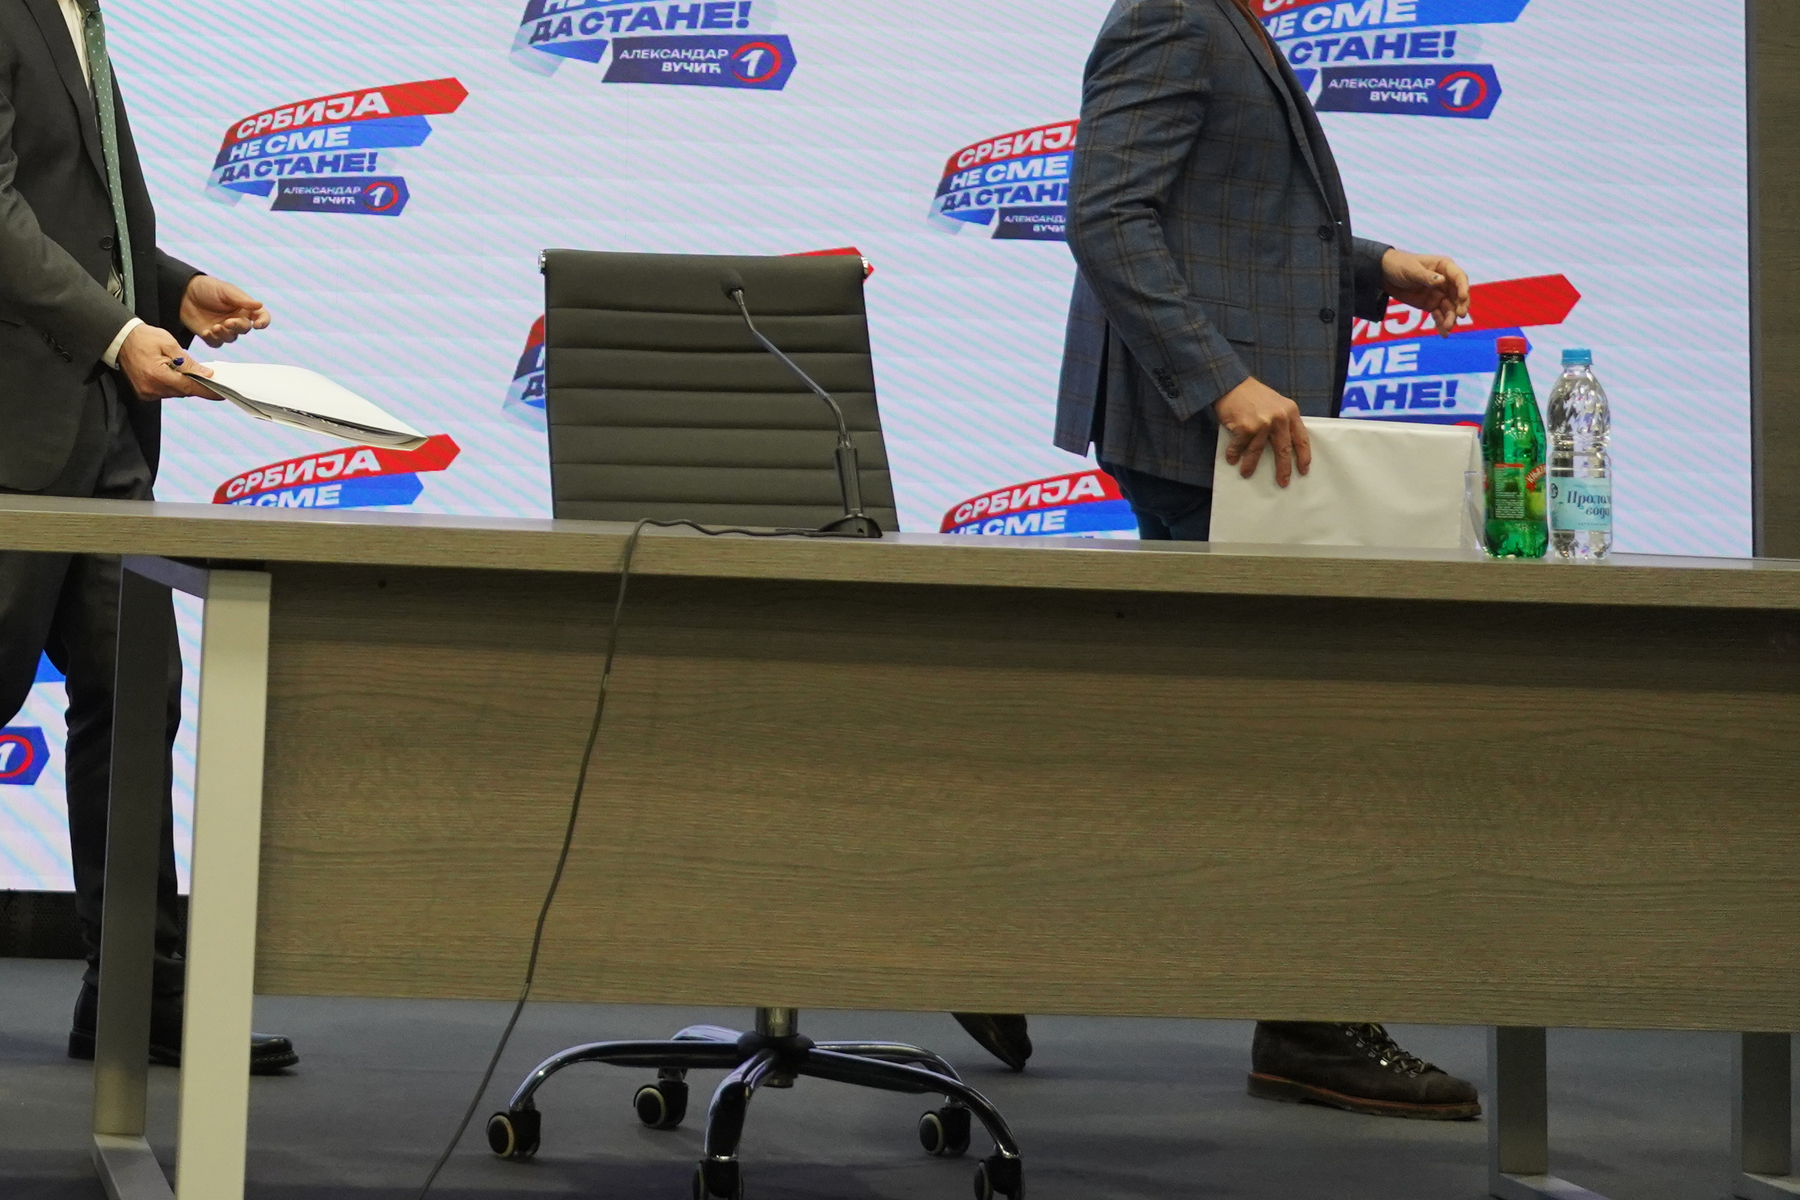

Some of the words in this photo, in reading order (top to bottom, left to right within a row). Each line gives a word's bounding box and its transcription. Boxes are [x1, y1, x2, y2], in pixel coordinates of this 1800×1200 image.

[528, 16, 574, 45] ДА
[579, 1, 752, 34] СТАНЕ!
[619, 49, 729, 61] АЛЕКСАНДАР
[1289, 31, 1456, 65] СТАНЕ!
[662, 62, 721, 73] ВУЧИЋ
[740, 50, 765, 76] 1
[1328, 78, 1436, 89] АЛЕКСАНДАР
[1370, 91, 1428, 103] ВУЧИЋ
[1447, 79, 1470, 105] 1
[236, 92, 390, 139] СРБИЈА
[229, 140, 262, 161] НЕ
[264, 126, 351, 153] СМЕ
[957, 125, 1076, 168] СРБИЈ
[218, 164, 250, 184] ДА
[253, 152, 378, 176] СТАНЕ!
[950, 168, 983, 191] НЕ
[985, 155, 1069, 182] СМЕ
[369, 187, 386, 206] 1
[940, 192, 971, 213] ДА
[226, 449, 381, 498] СРБИЈА
[954, 475, 1105, 523] СРБИЈА
[982, 509, 1067, 536] СМЕ
